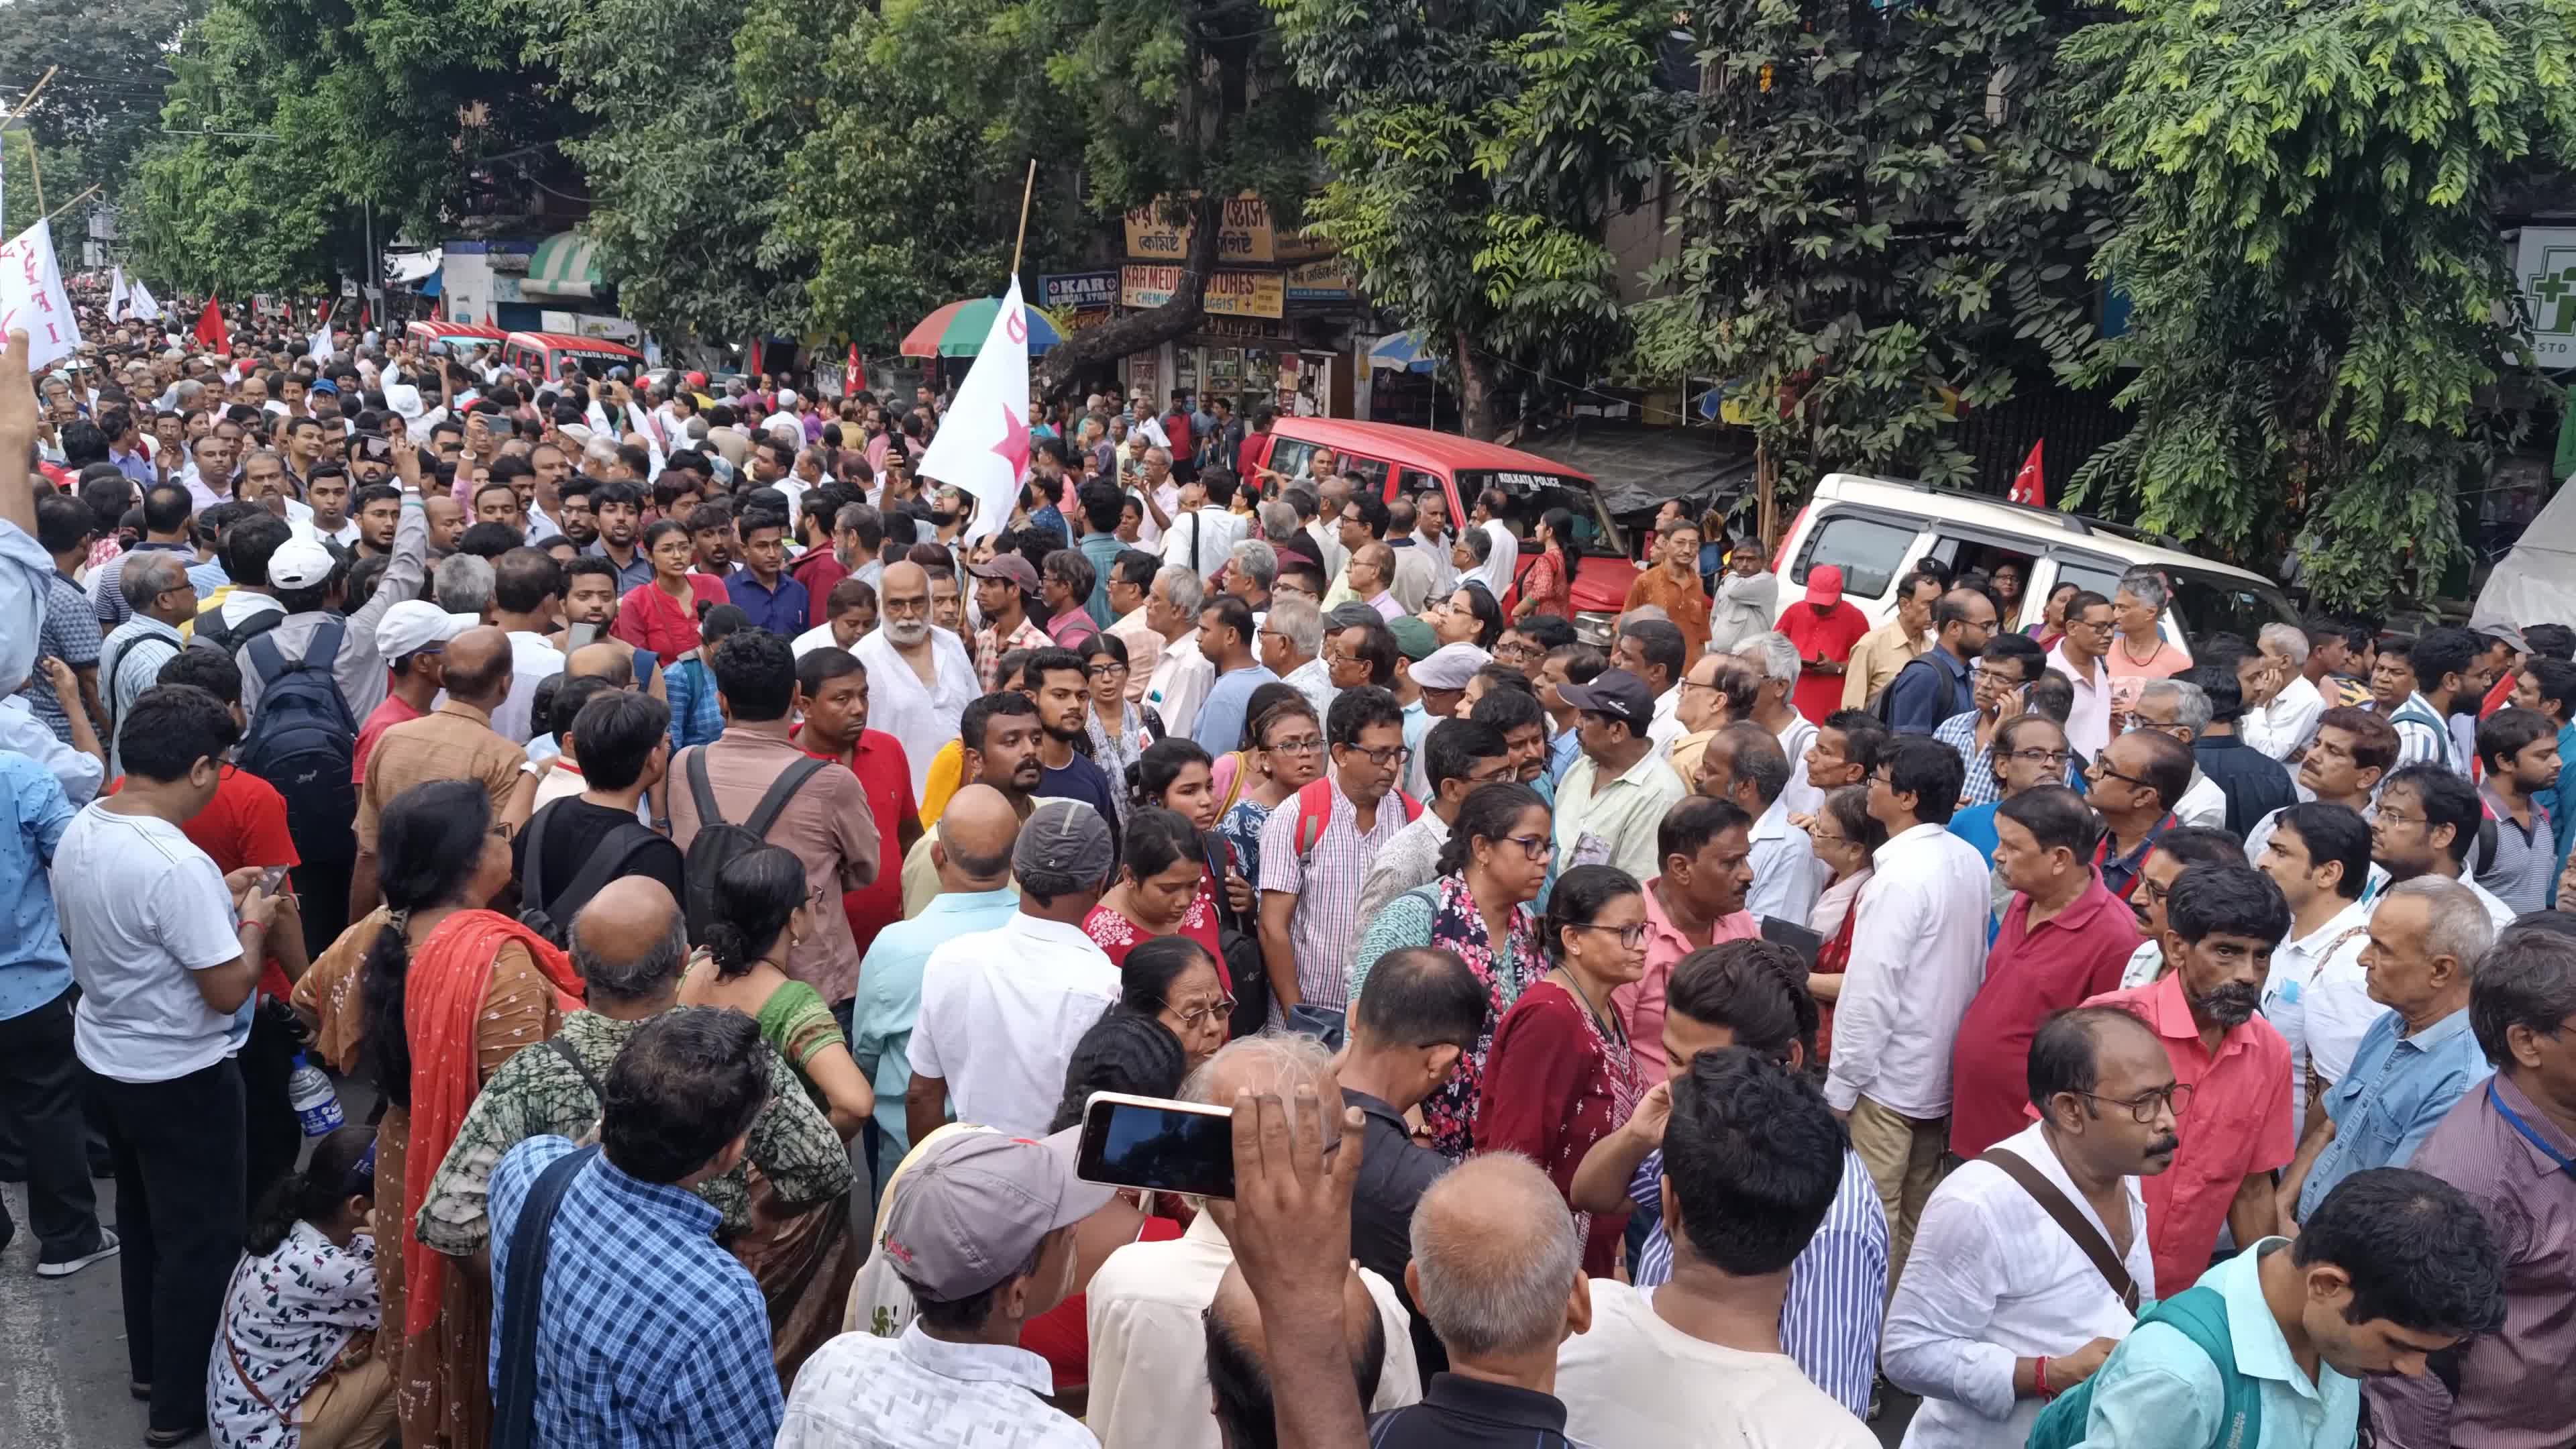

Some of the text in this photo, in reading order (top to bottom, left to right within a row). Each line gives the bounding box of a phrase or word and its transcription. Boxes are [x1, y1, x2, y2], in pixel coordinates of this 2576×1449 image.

[1124, 266, 1146, 288] KAR
[1060, 278, 1106, 293] KAR
[566, 350, 629, 362] KOLKATA POLICE
[1498, 472, 1561, 487] KOLKATA POLICE
